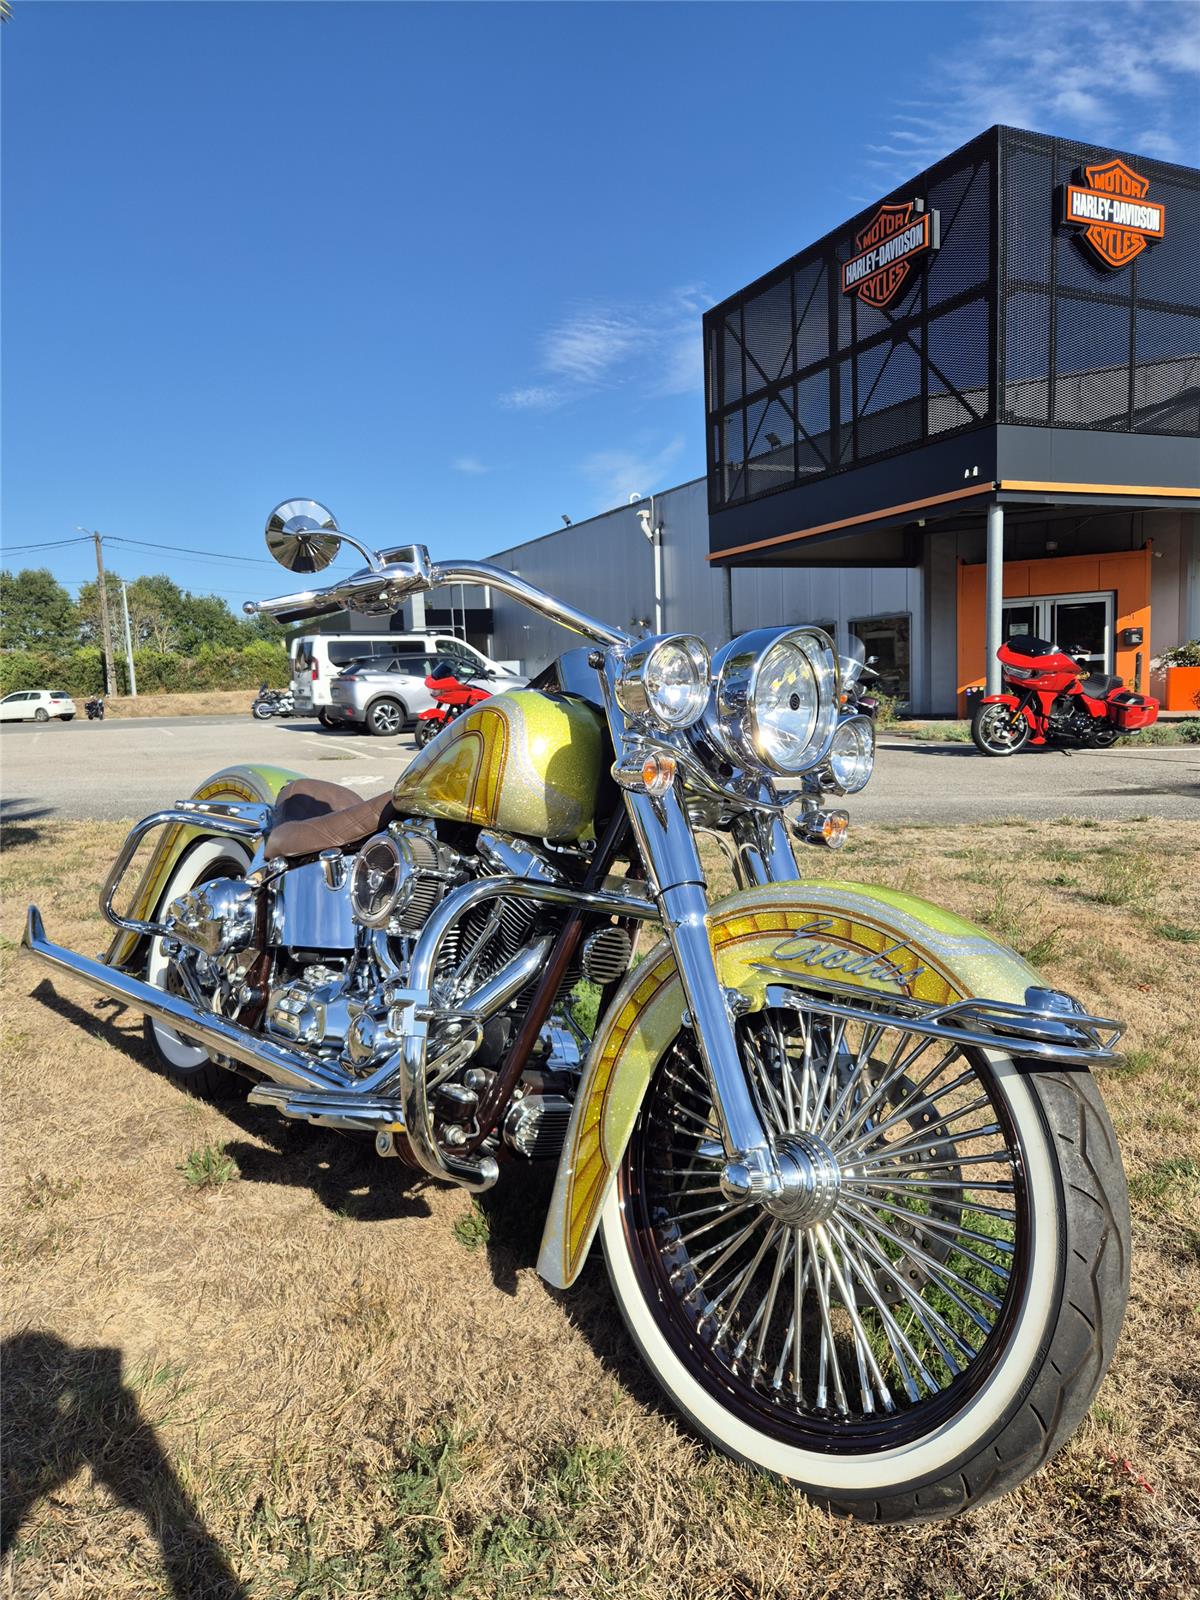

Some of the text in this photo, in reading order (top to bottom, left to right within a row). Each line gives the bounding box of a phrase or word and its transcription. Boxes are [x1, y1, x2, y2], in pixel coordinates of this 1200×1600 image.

[1094, 167, 1142, 198] MOTOR
[1072, 191, 1160, 231] HARLEY-DAVIDSON
[863, 213, 903, 249] MOTOR
[1092, 225, 1141, 260] CYCLES
[846, 222, 924, 286] HARLEY-DAVIDSON
[862, 262, 905, 300] CYCLES
